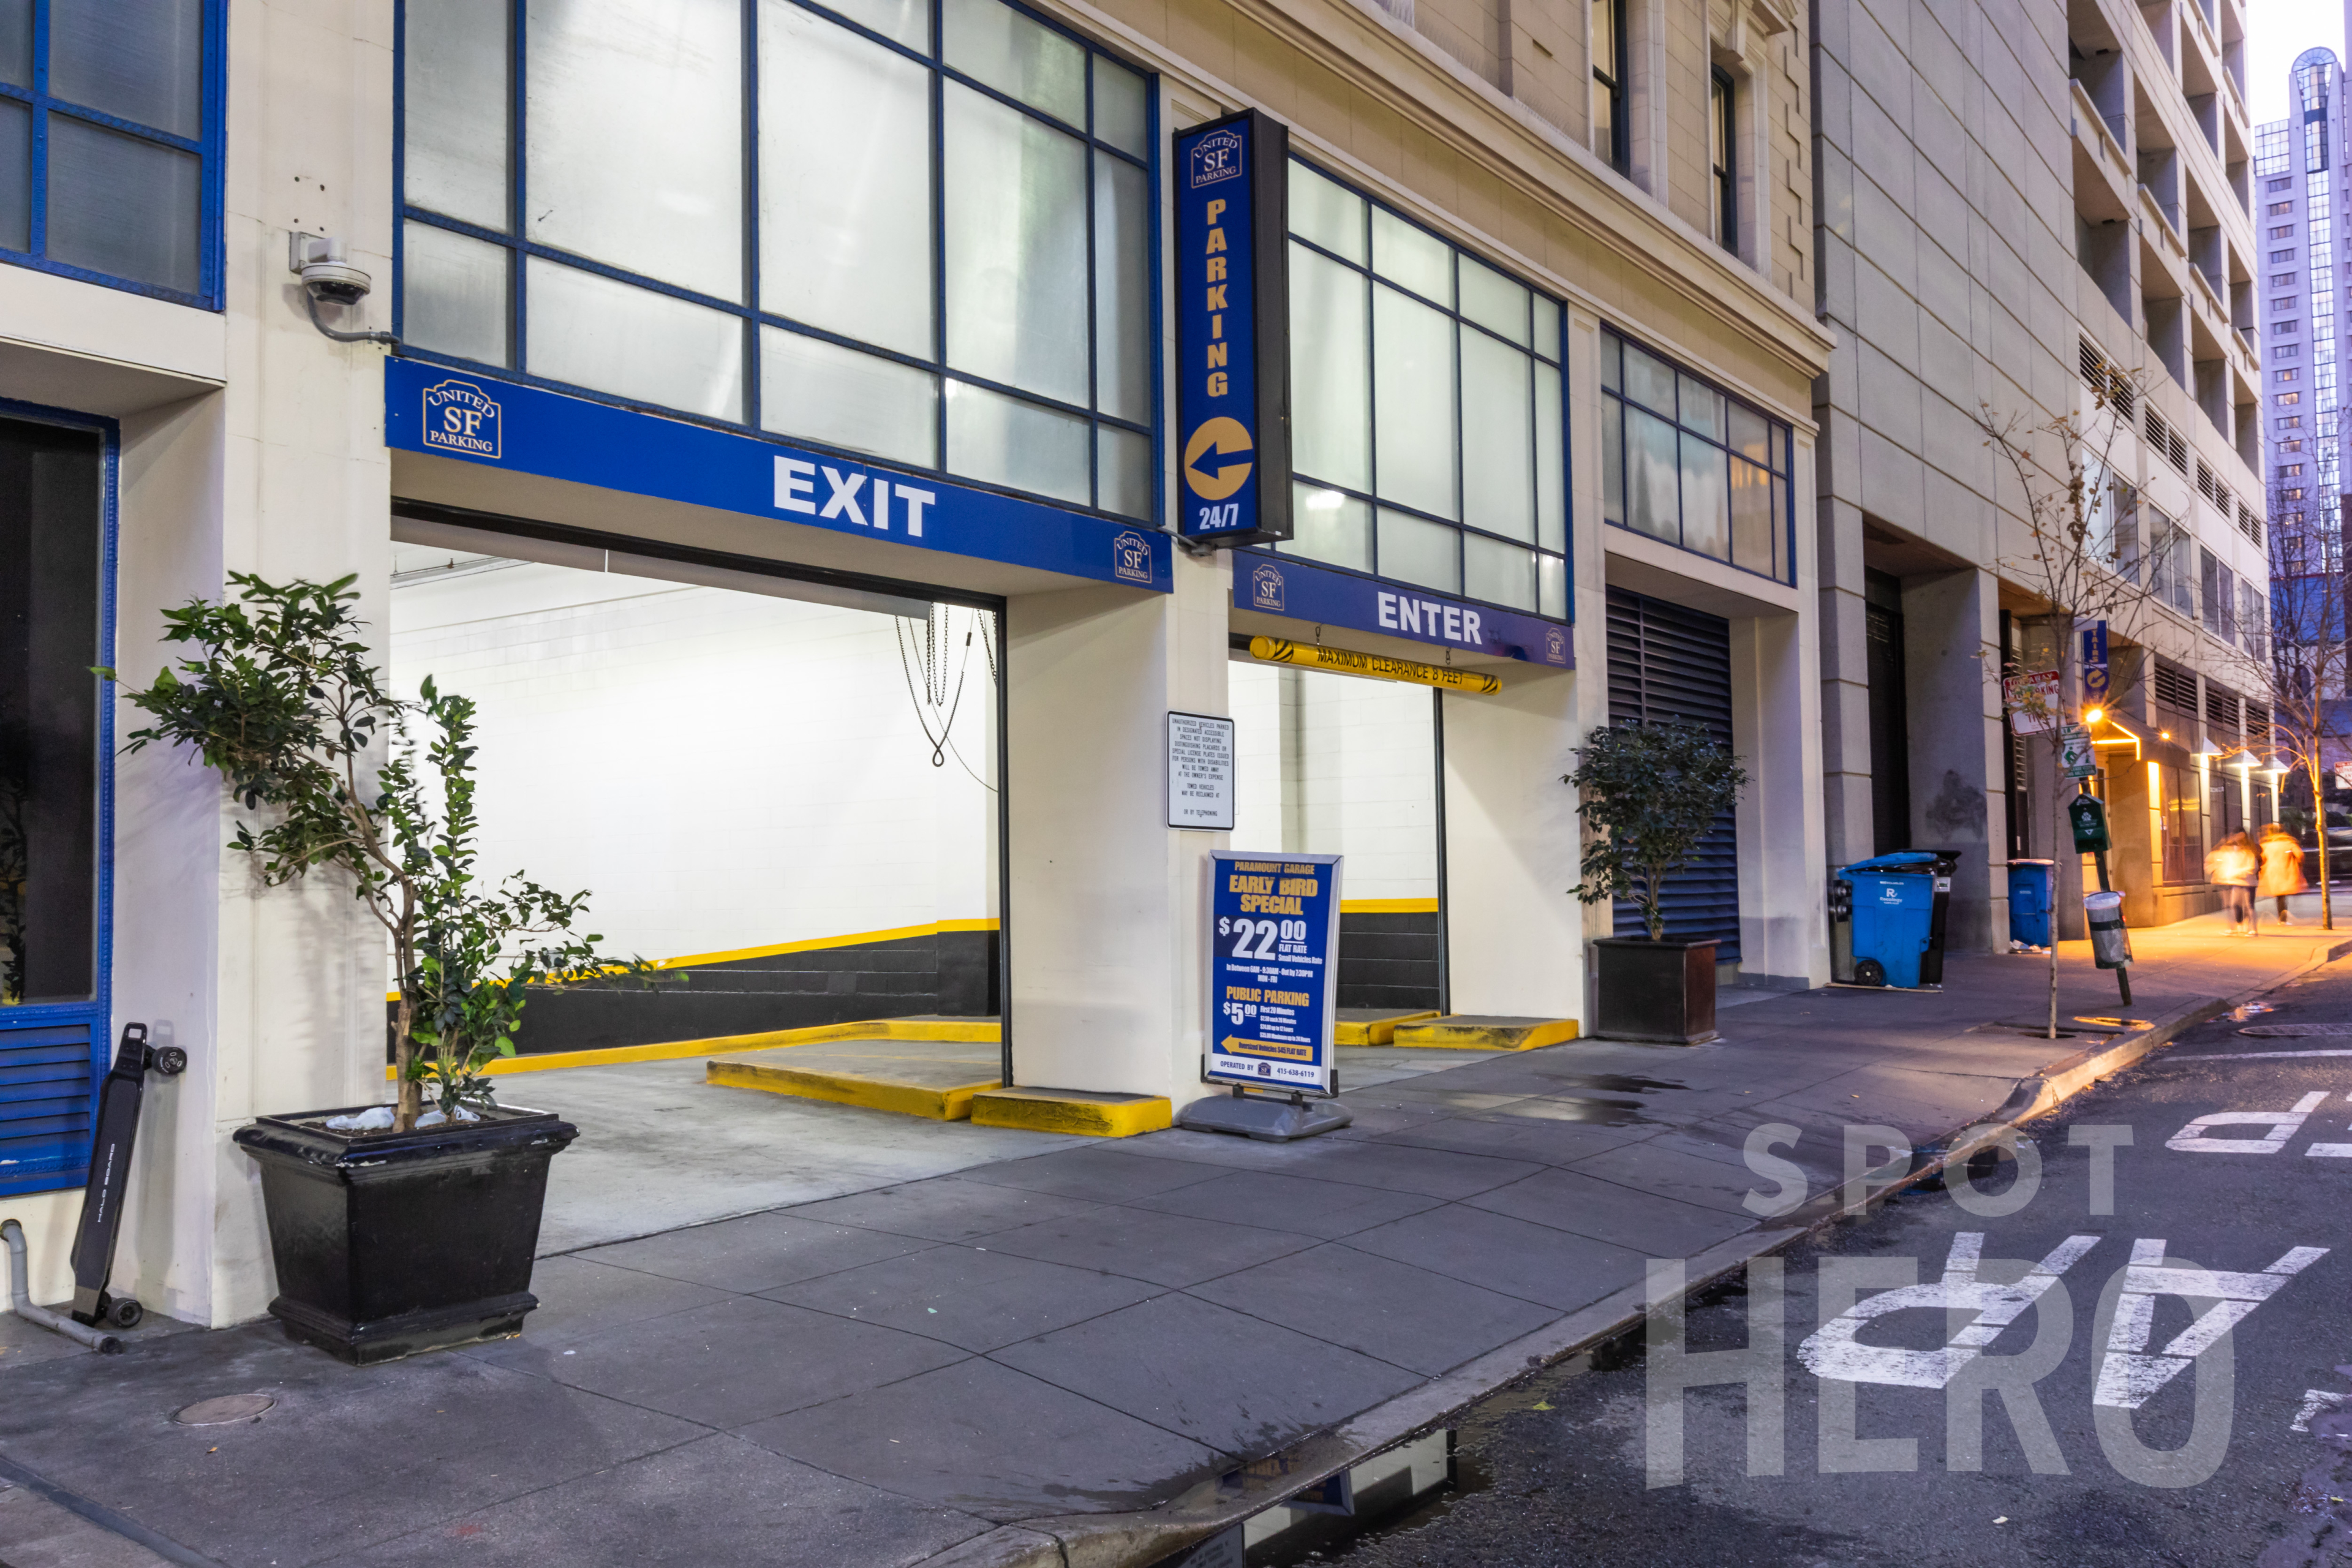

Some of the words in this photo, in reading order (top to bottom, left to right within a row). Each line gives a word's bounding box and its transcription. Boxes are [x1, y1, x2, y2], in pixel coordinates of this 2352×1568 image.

[1194, 137, 1237, 158] UNITED
[1204, 148, 1229, 172] SF
[1196, 166, 1236, 184] PARKING
[1206, 198, 1228, 397] PARKING
[427, 390, 495, 418] UNITED
[443, 407, 482, 436] SF
[430, 430, 492, 452] PARKING
[774, 455, 935, 537] EXIT
[1199, 503, 1238, 530] 24/7
[1117, 538, 1148, 555] UNITED
[1125, 549, 1142, 568] SF
[1118, 567, 1148, 579] PARKING
[1255, 570, 1281, 586] UNITED
[1261, 581, 1276, 598] SF
[1256, 596, 1281, 607] PARKING
[1378, 592, 1482, 645] ENTER
[1551, 641, 1560, 654] SF
[1317, 647, 1367, 669] MAXIMUM
[1373, 657, 1428, 680] CLEARANCE
[1433, 668, 1439, 680] 8
[1441, 669, 1464, 685] FEET
[1234, 861, 1282, 873] PARAMOUNT
[1284, 863, 1315, 875] GARAGE
[1229, 875, 1275, 894] EARLY
[1279, 877, 1318, 897] BIRD
[1240, 894, 1303, 915] SPECIAL
[1278, 943, 1292, 952] FLAT
[1292, 945, 1307, 954] RATE
[1226, 986, 1261, 1002] PUBLIC
[1264, 989, 1310, 1006] PARKING
[1238, 1042, 1258, 1050] Oversized
[1259, 1044, 1277, 1053] Vehicles
[1220, 1060, 1245, 1069] OPERATED
[1276, 1068, 1314, 1078] 415-638-6119
[97, 1189, 107, 1223] HALO
[104, 1144, 115, 1185] BOARD
